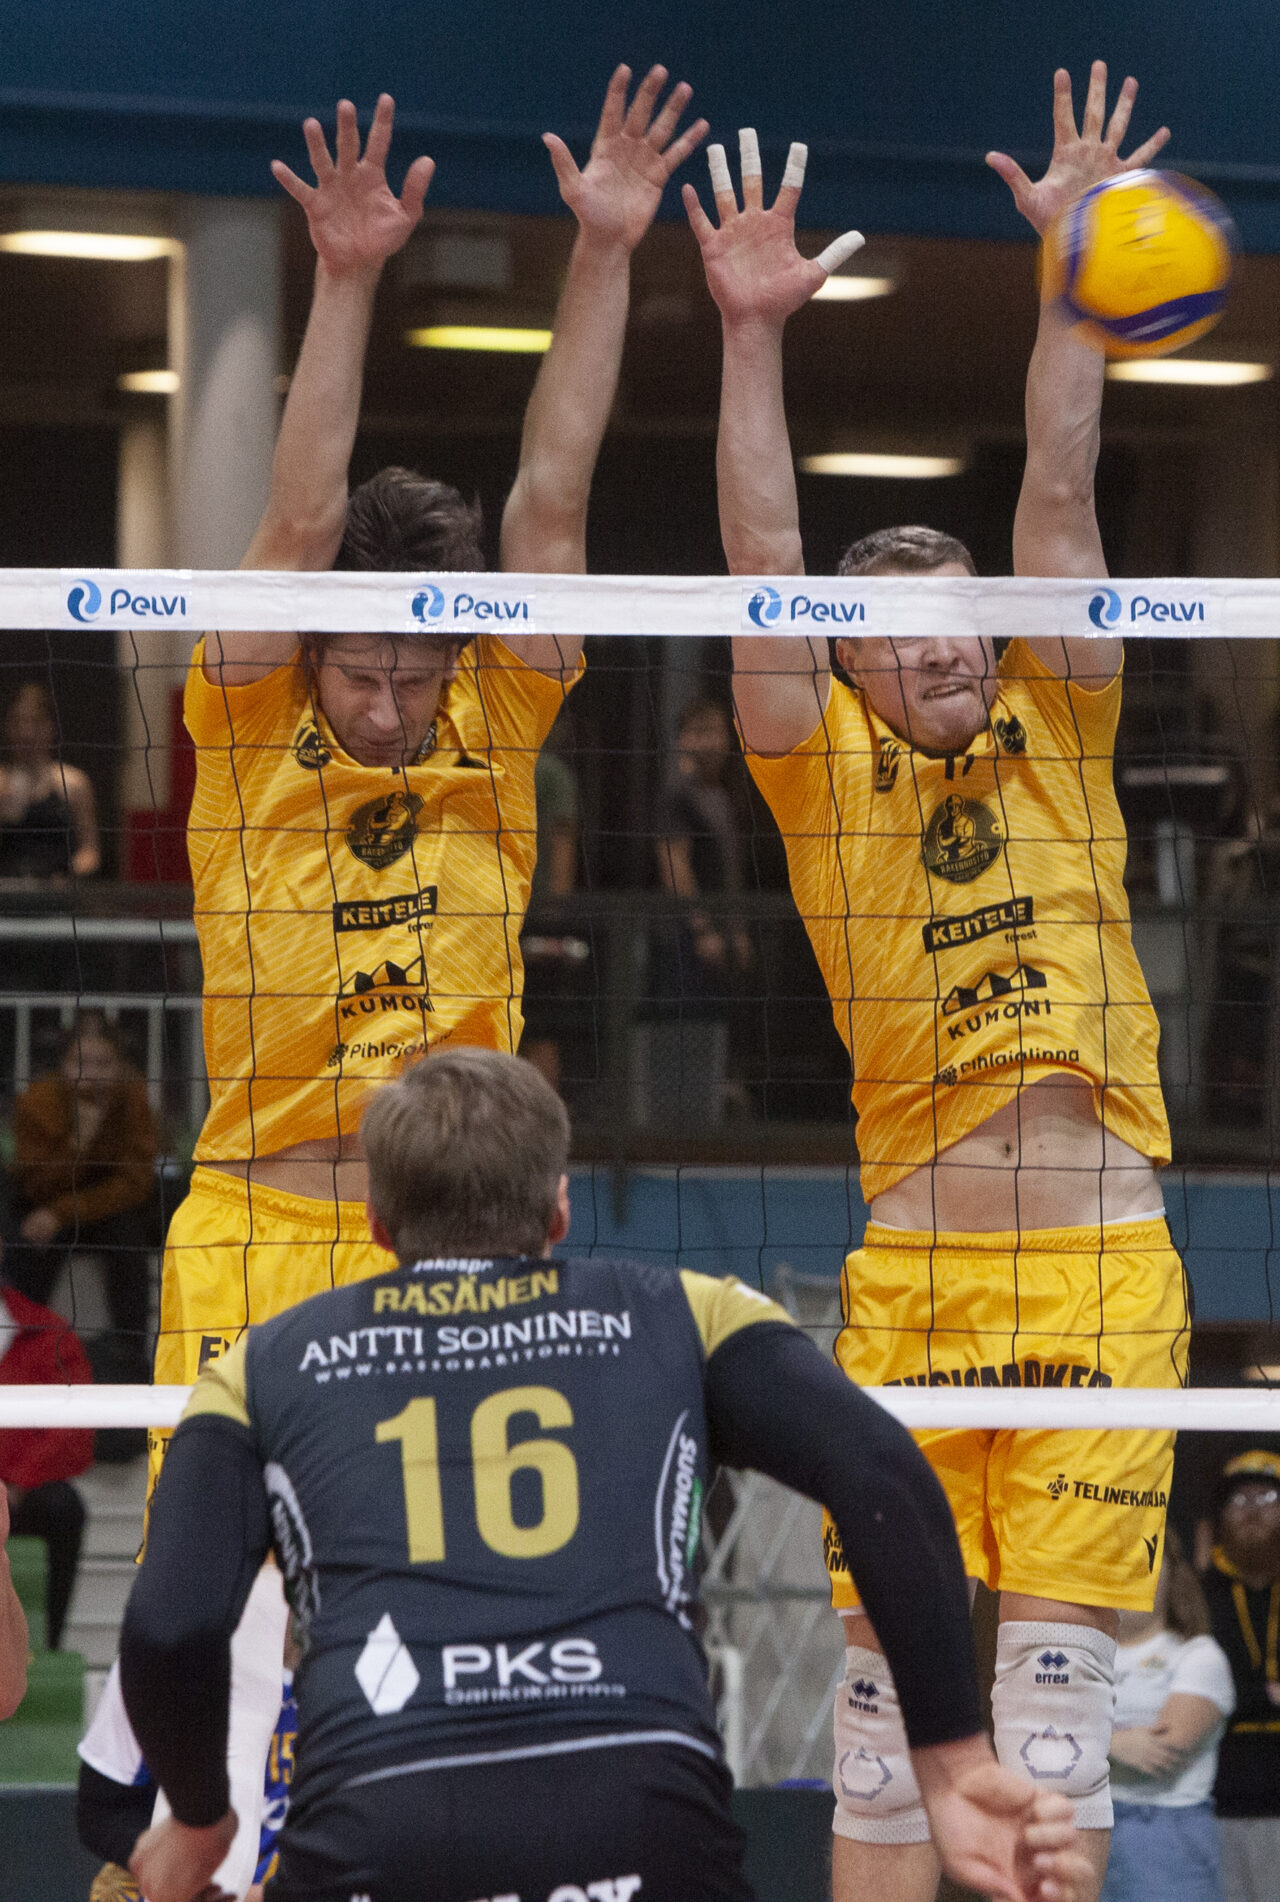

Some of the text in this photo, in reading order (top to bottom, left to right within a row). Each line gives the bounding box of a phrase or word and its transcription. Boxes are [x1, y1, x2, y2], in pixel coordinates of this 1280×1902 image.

[341, 892, 432, 926] KEITELE
[931, 902, 1027, 946] KEITELE
[947, 999, 1052, 1042] KUMONI
[299, 1309, 633, 1372] ANTTI SOININEN
[373, 1384, 581, 1564] 16
[441, 1637, 603, 1690] PKS
